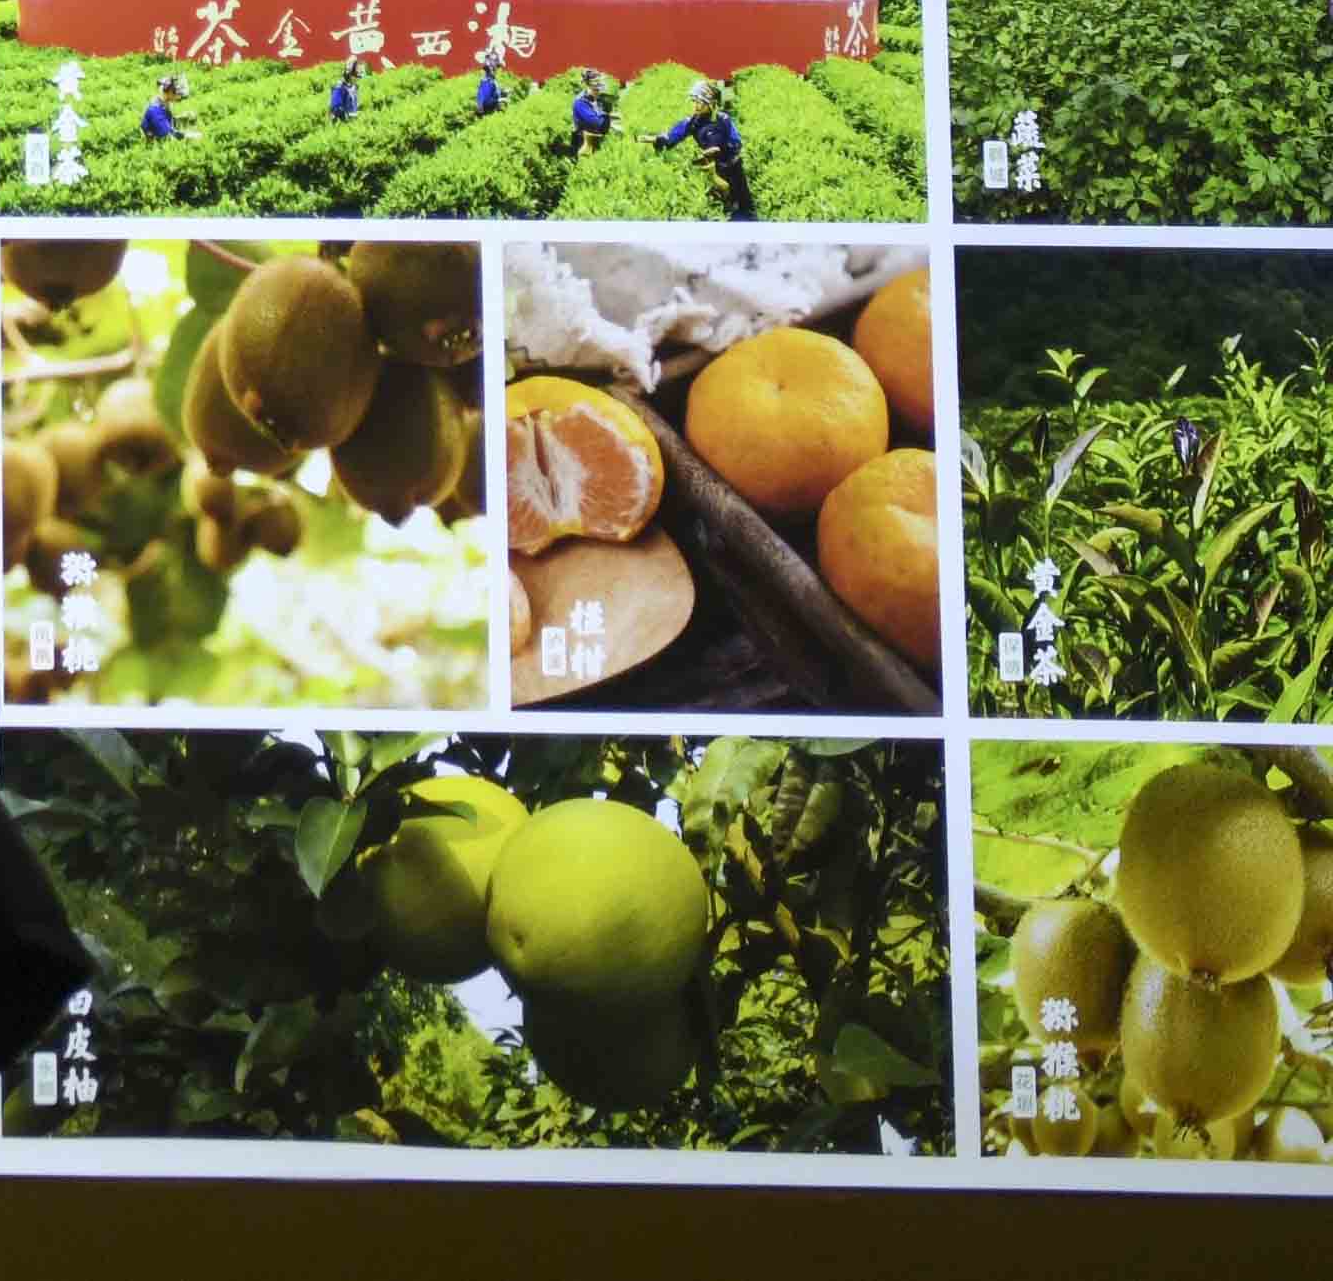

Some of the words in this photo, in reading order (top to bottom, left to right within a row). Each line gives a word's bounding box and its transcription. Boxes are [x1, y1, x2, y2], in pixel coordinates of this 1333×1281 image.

[1010, 109, 1045, 192] 蔬菜
[1026, 557, 1068, 687] 黄金茶
[1040, 996, 1081, 1123] 猕猴桃
